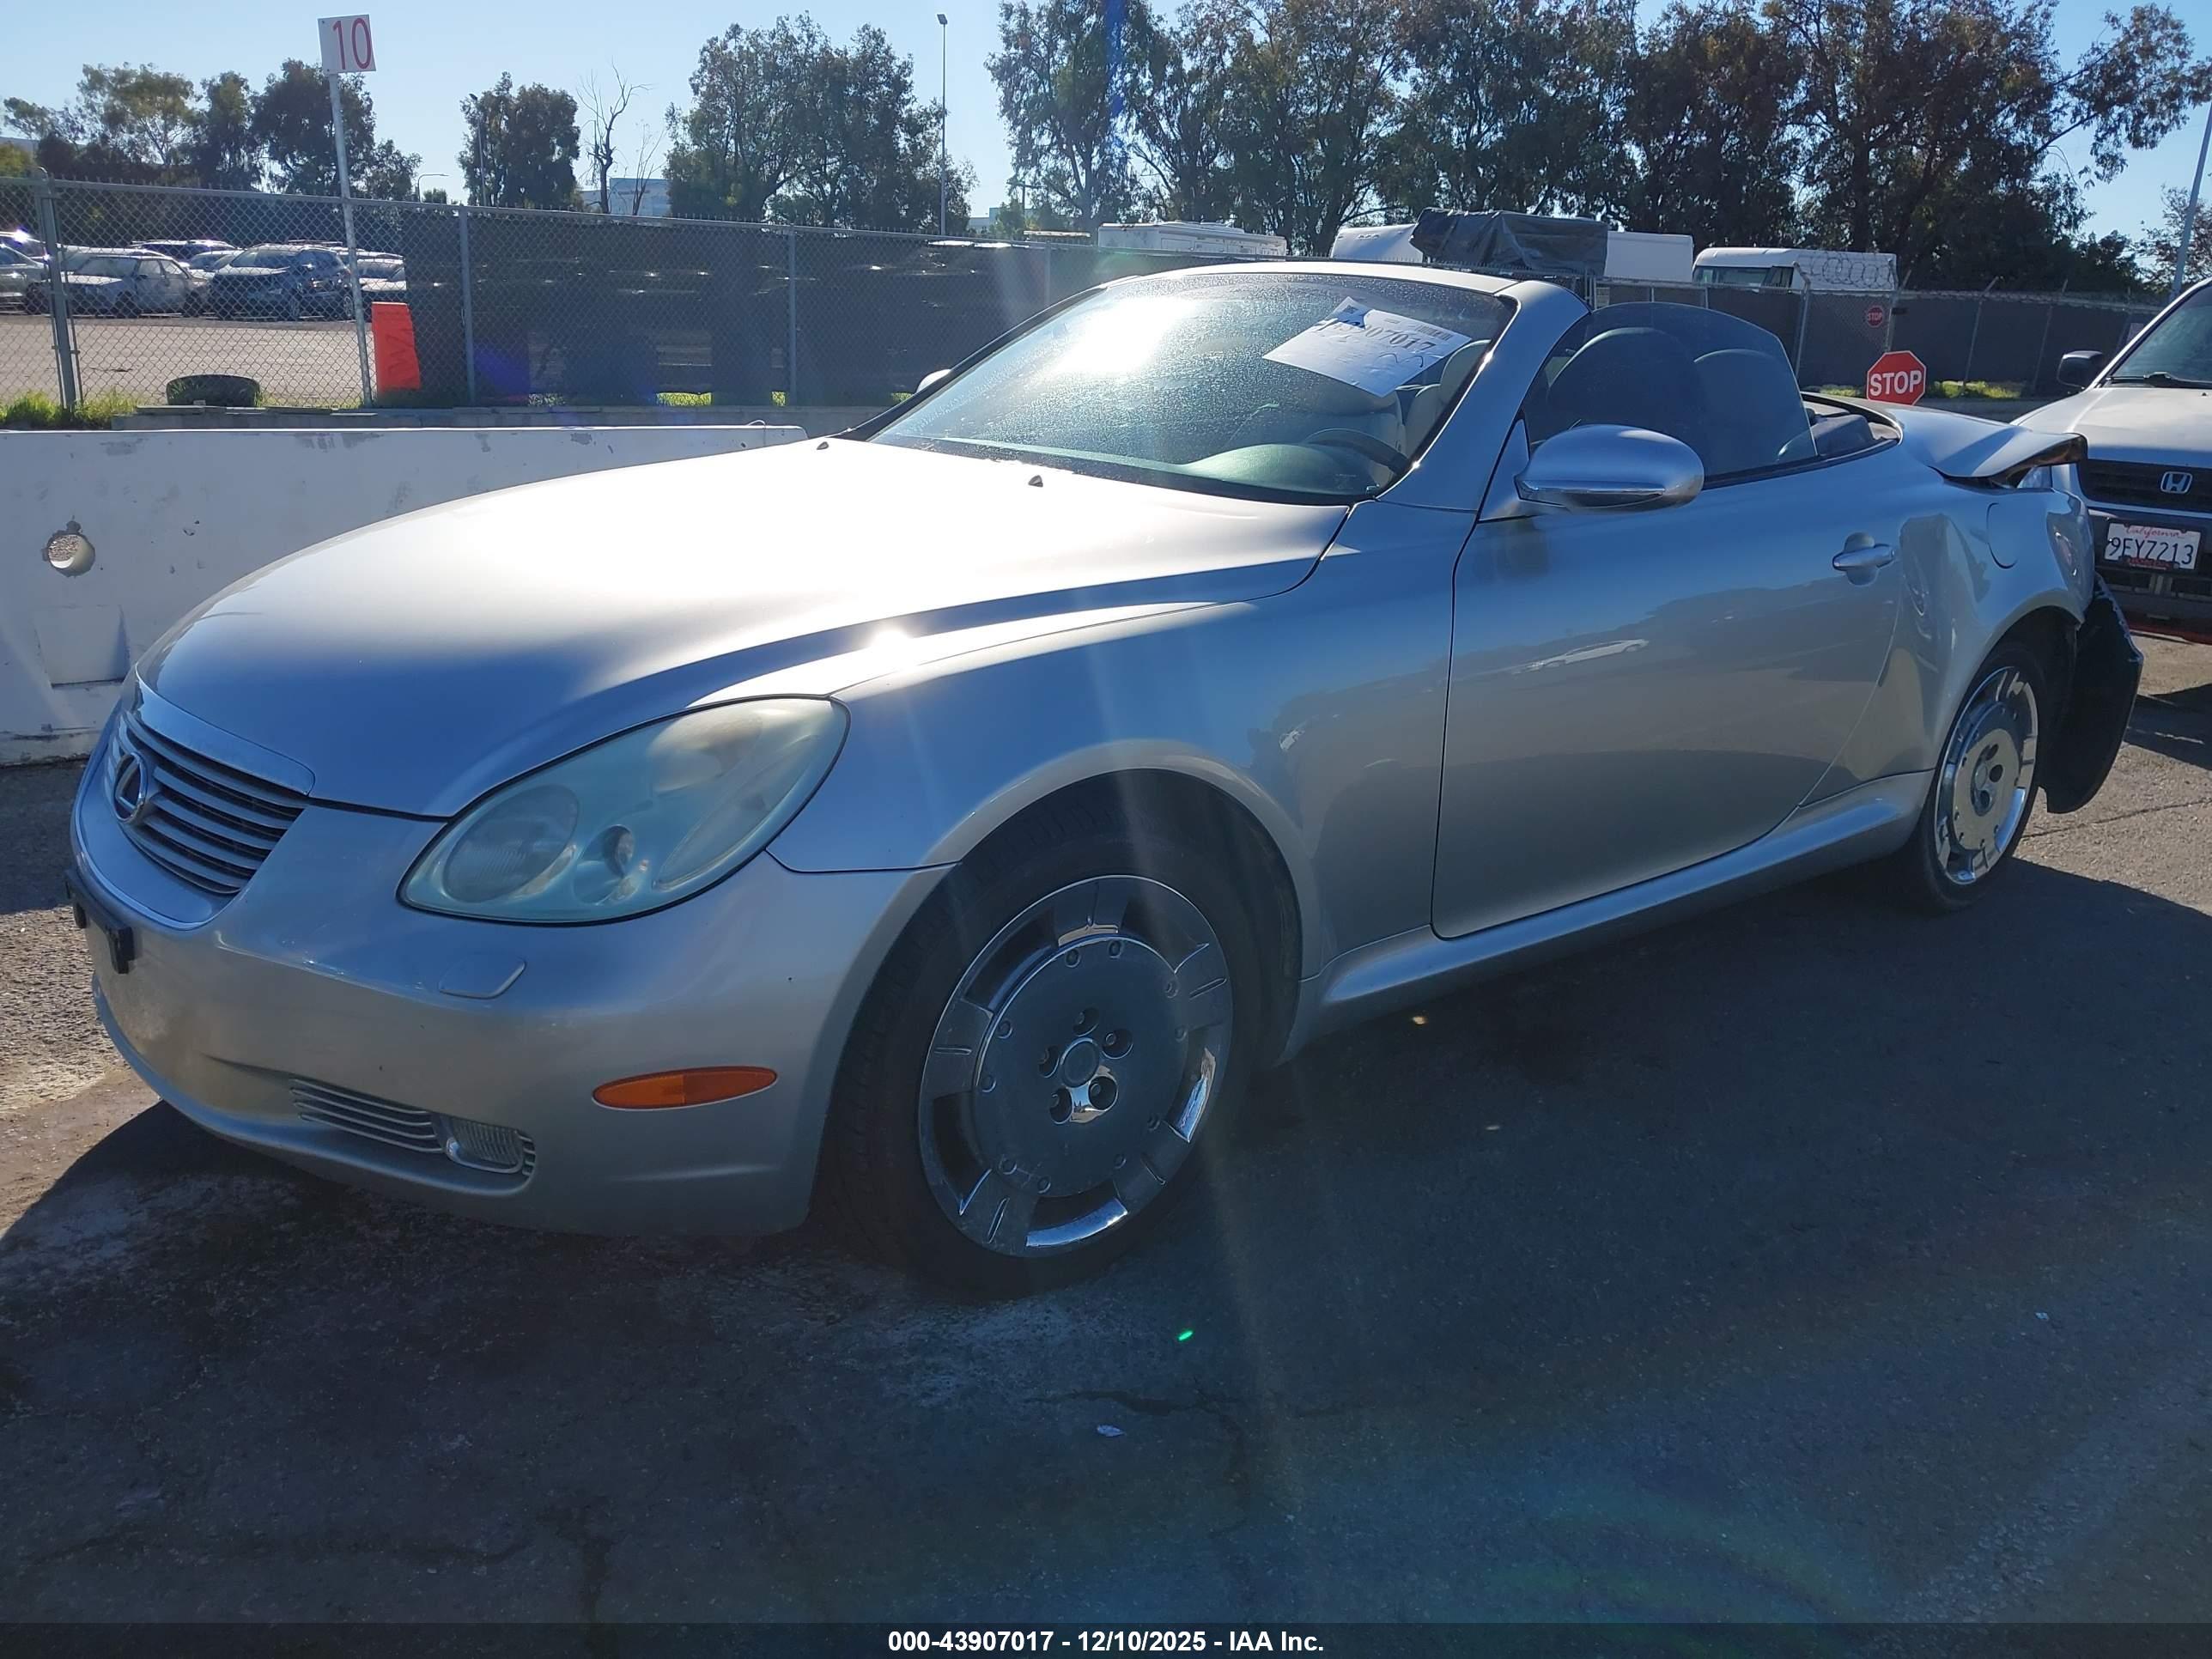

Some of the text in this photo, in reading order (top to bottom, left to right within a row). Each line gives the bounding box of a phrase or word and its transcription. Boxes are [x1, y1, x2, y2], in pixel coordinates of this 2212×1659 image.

[332, 17, 372, 70] 10
[1868, 312, 1883, 321] STOP
[1869, 369, 1922, 397] STOP
[2126, 526, 2180, 539] California
